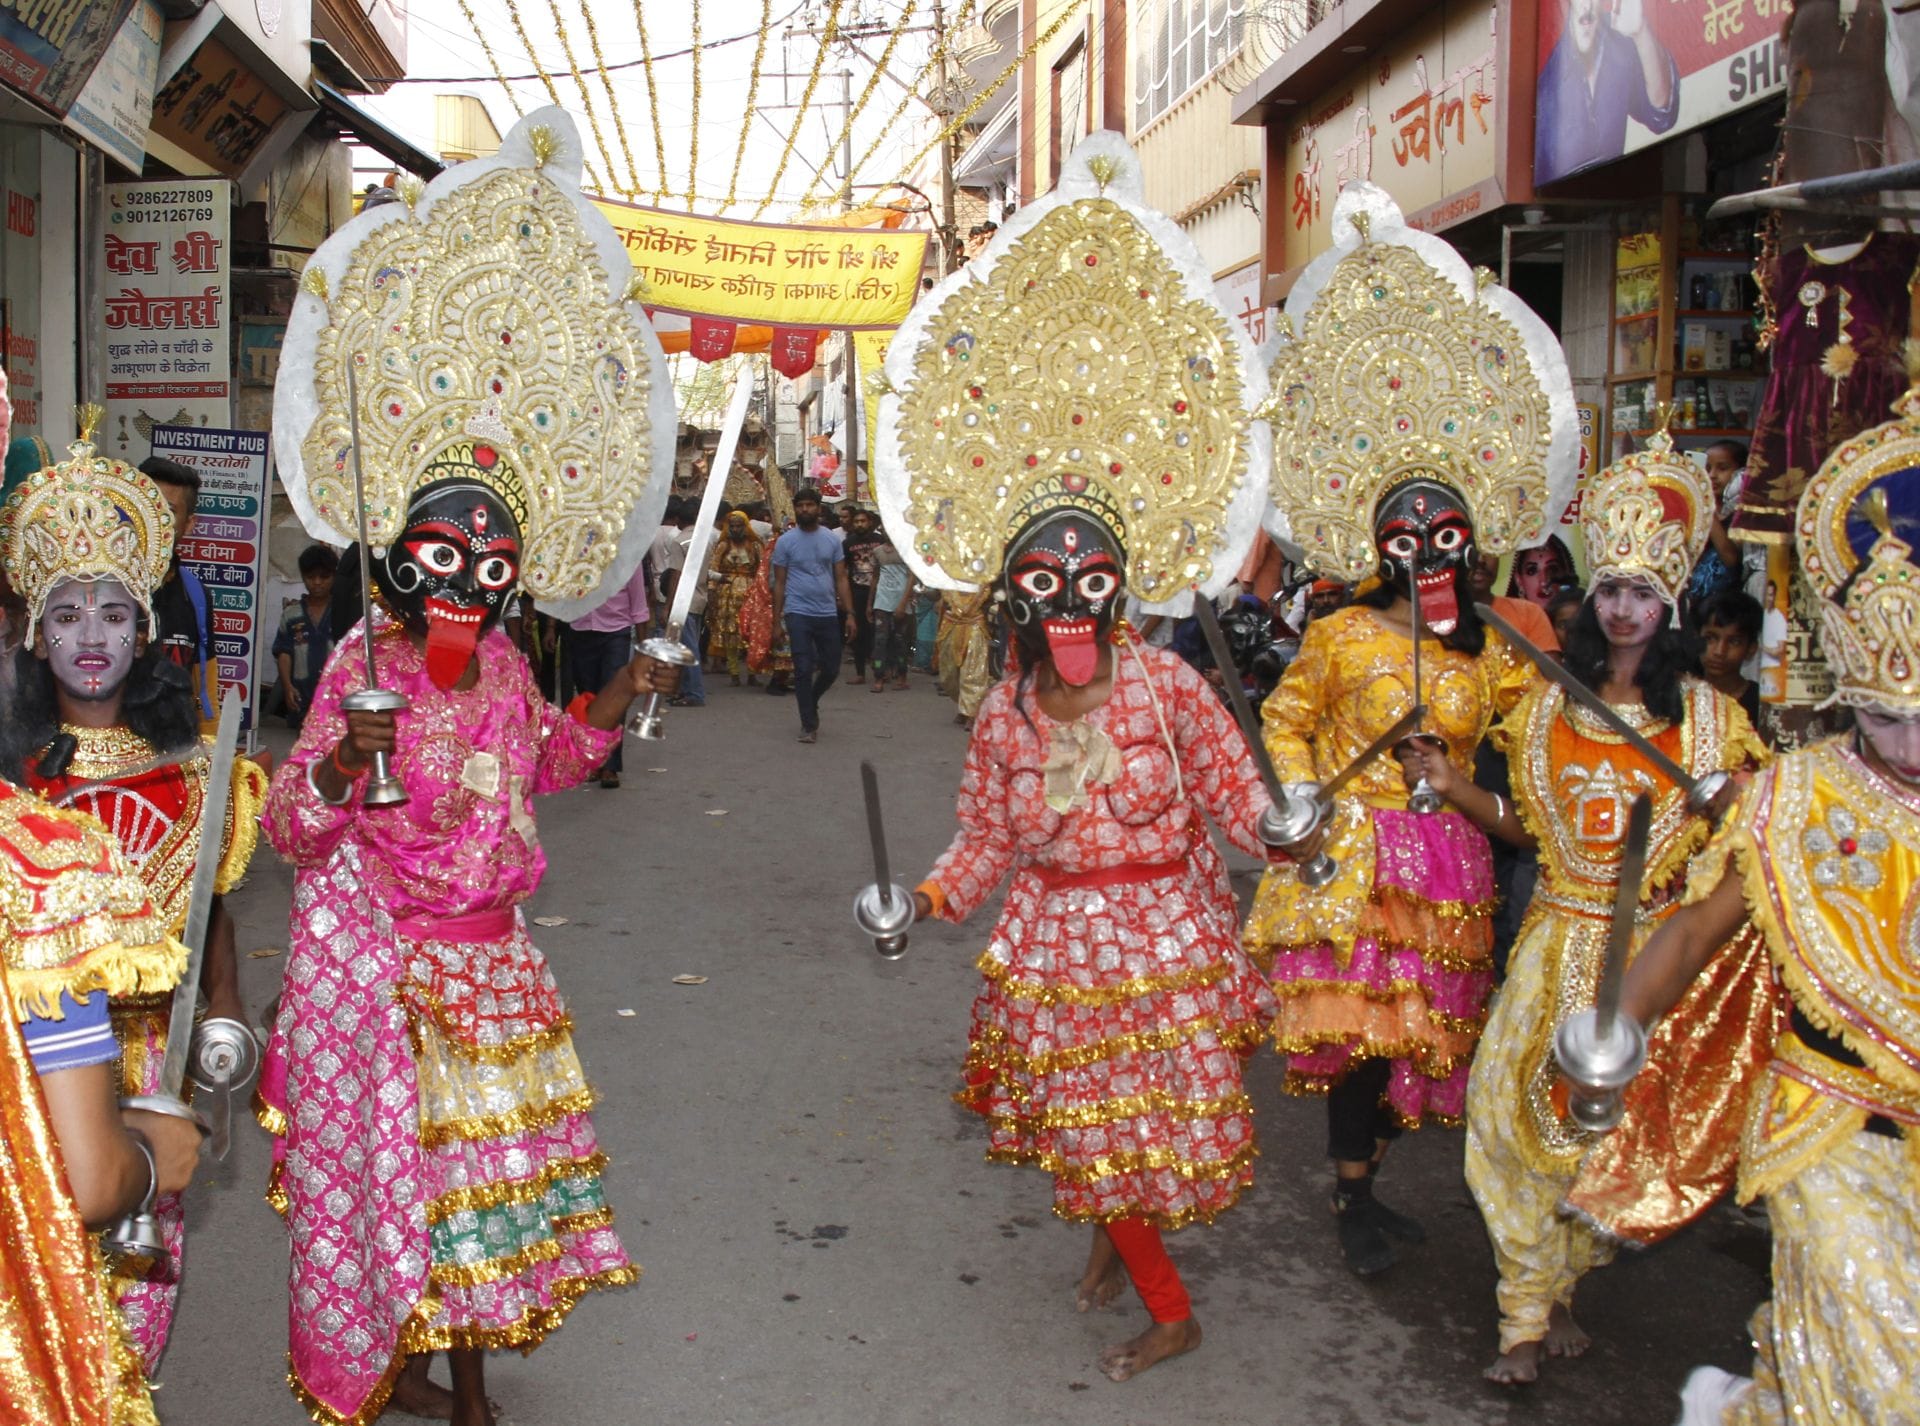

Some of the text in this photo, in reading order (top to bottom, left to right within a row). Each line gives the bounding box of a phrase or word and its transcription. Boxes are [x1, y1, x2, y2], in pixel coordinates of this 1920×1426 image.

[127, 190, 213, 205] 9286227809
[7, 190, 36, 237] HUB
[126, 209, 213, 223] 9012126769
[105, 231, 222, 274] देव श्री
[105, 285, 222, 329] ज्वैलर्स
[108, 343, 131, 359] शुद्ध
[134, 339, 158, 354] सोने
[162, 344, 170, 354] व
[202, 339, 213, 353] के
[111, 359, 210, 378] आभूषण के विक्रेता
[154, 430, 265, 452] INVESTMENT HUB
[201, 455, 251, 469] रस्तोगी
[217, 496, 248, 510] फण्ड
[212, 520, 243, 538] बीमा
[199, 543, 237, 560] बीमा
[223, 566, 247, 583] बीमा
[221, 617, 246, 631] साथ
[214, 640, 243, 654] लान
